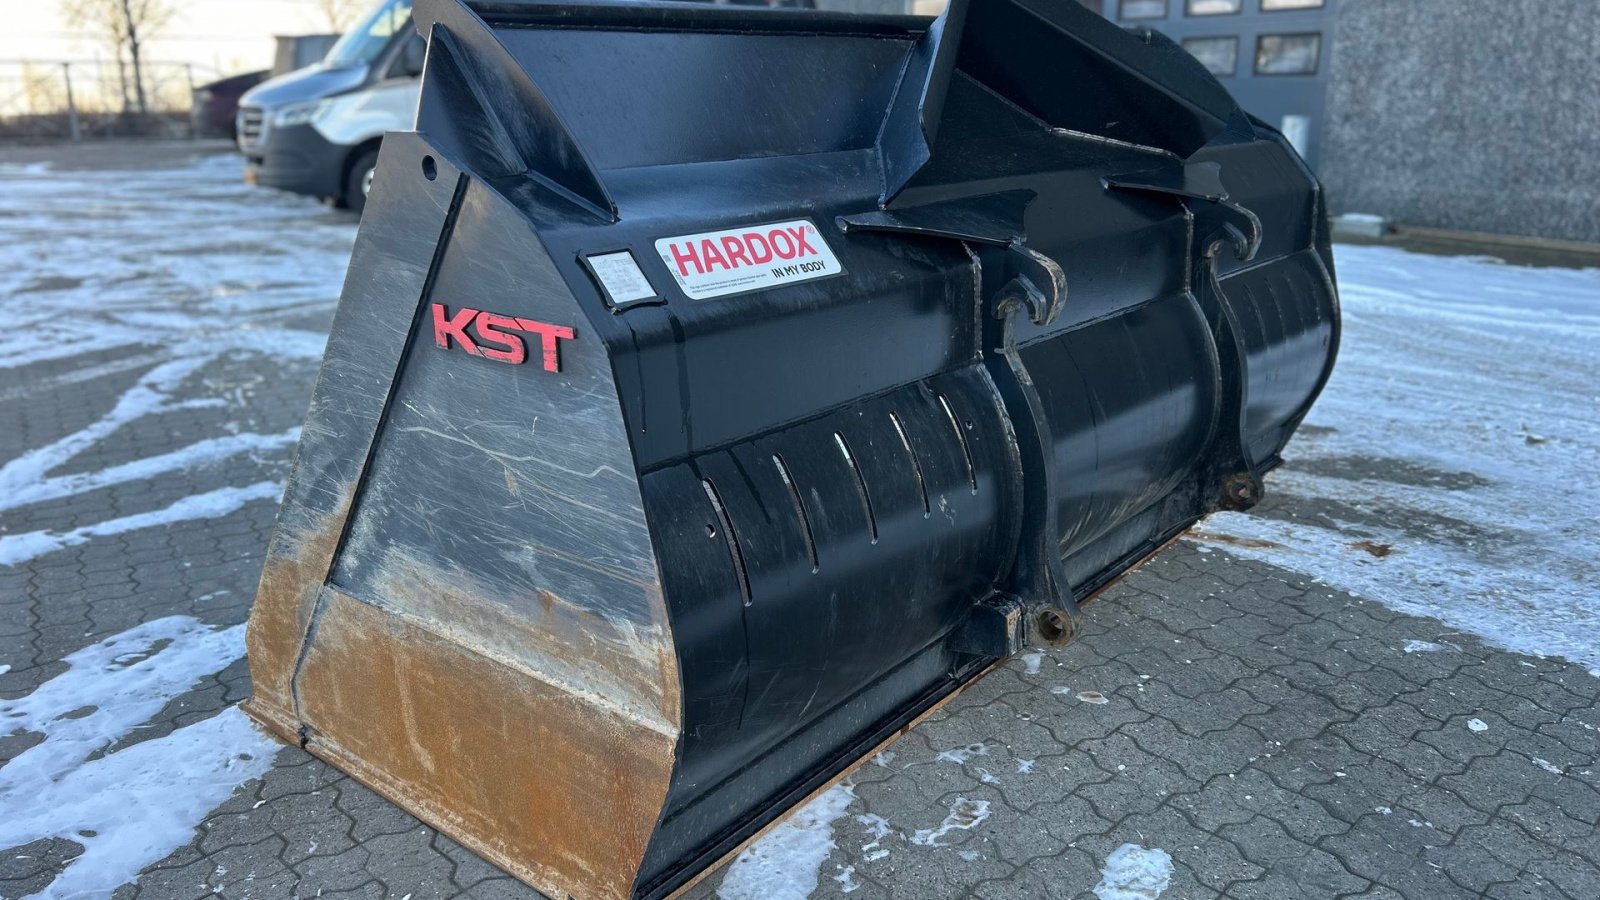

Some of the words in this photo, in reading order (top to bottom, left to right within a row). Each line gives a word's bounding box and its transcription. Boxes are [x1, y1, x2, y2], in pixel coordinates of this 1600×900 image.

[771, 267, 785, 279] IN
[783, 264, 800, 277] MY
[799, 260, 826, 273] BODY
[432, 303, 576, 373] KST
